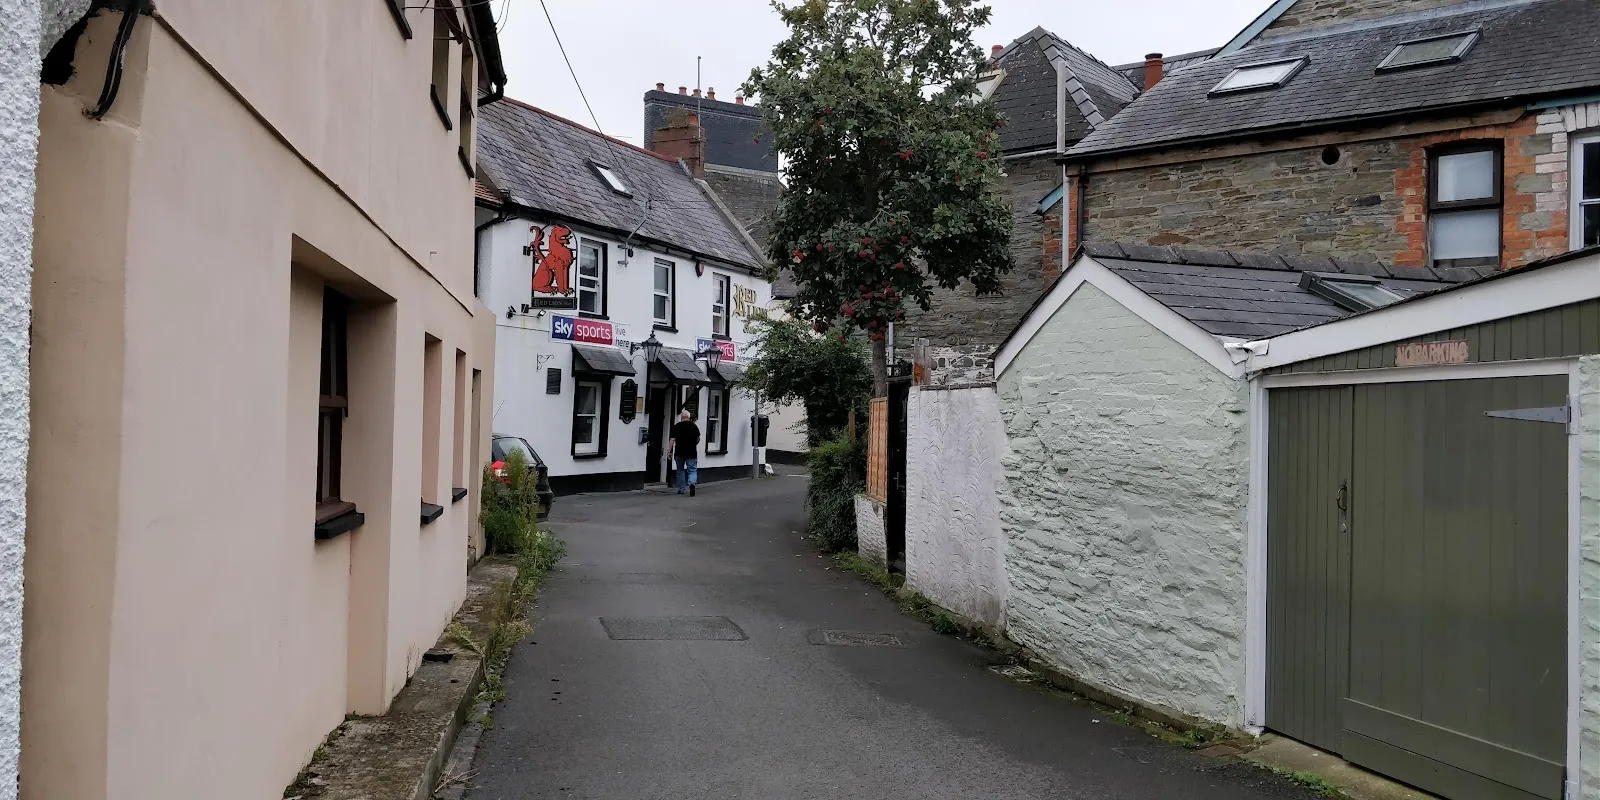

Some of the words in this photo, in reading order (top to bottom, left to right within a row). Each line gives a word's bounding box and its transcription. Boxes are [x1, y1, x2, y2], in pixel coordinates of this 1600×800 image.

[533, 298, 548, 307] RED
[555, 319, 573, 338] sky
[576, 324, 611, 340] sports
[615, 325, 626, 336] live
[615, 337, 630, 348] here
[1397, 346, 1412, 363] NO
[1415, 342, 1469, 363] PARKING
